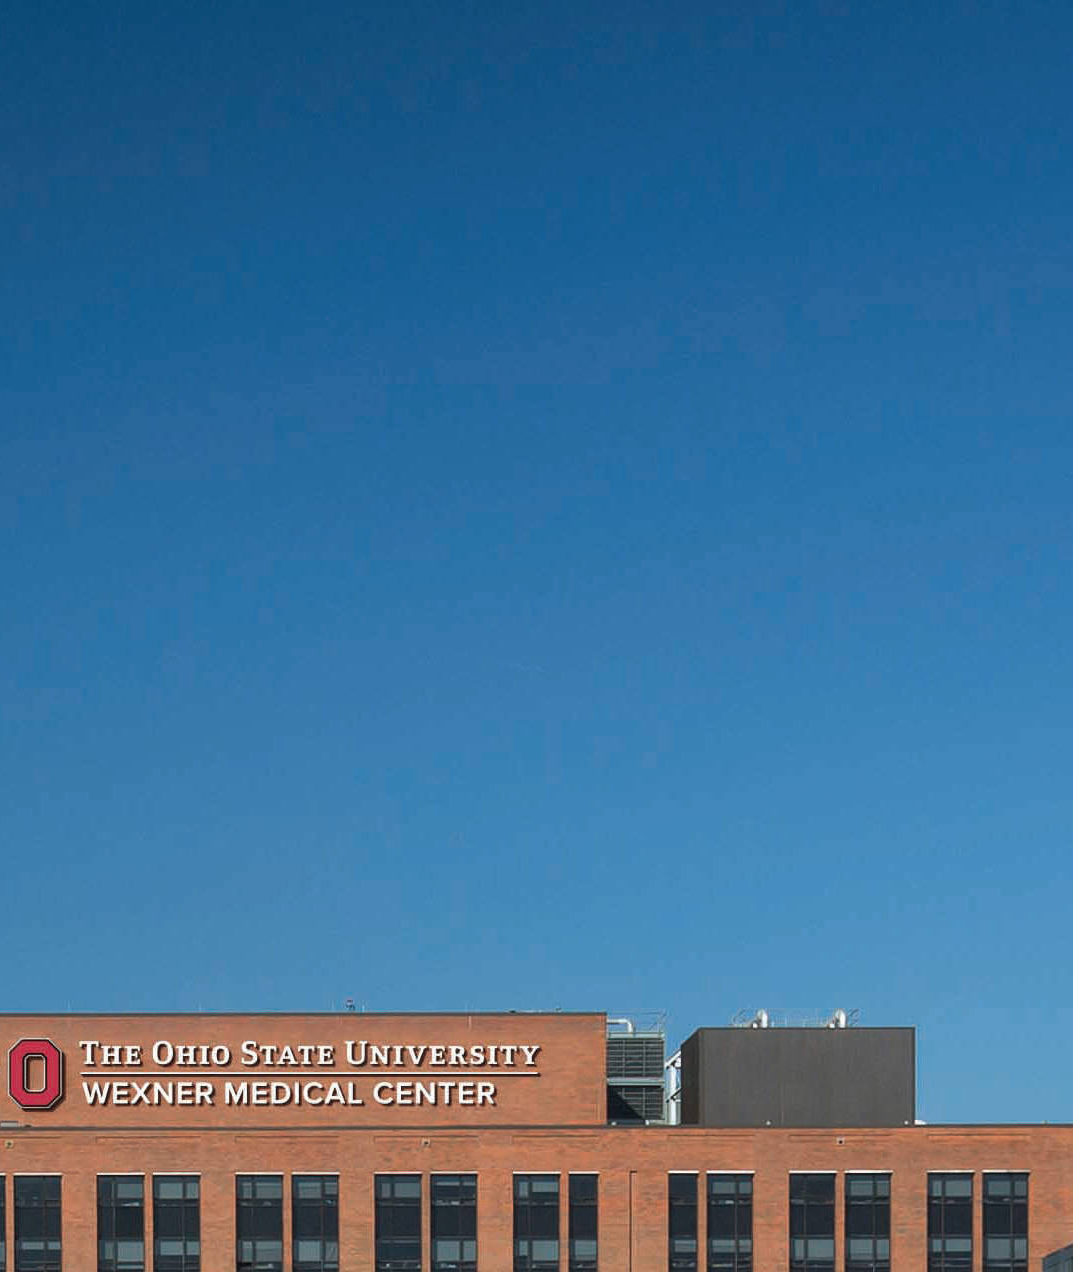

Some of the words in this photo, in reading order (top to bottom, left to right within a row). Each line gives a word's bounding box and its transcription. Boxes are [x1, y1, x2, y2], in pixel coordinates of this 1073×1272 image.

[79, 1040, 142, 1066] THE
[152, 1040, 231, 1066] OHIO
[240, 1040, 335, 1066] STATE
[344, 1040, 542, 1066] UNIVERSITY
[7, 1038, 63, 1109] O
[81, 1081, 214, 1105] WEXNER
[224, 1081, 363, 1105] MEDICAL
[372, 1081, 497, 1105] CENTER
